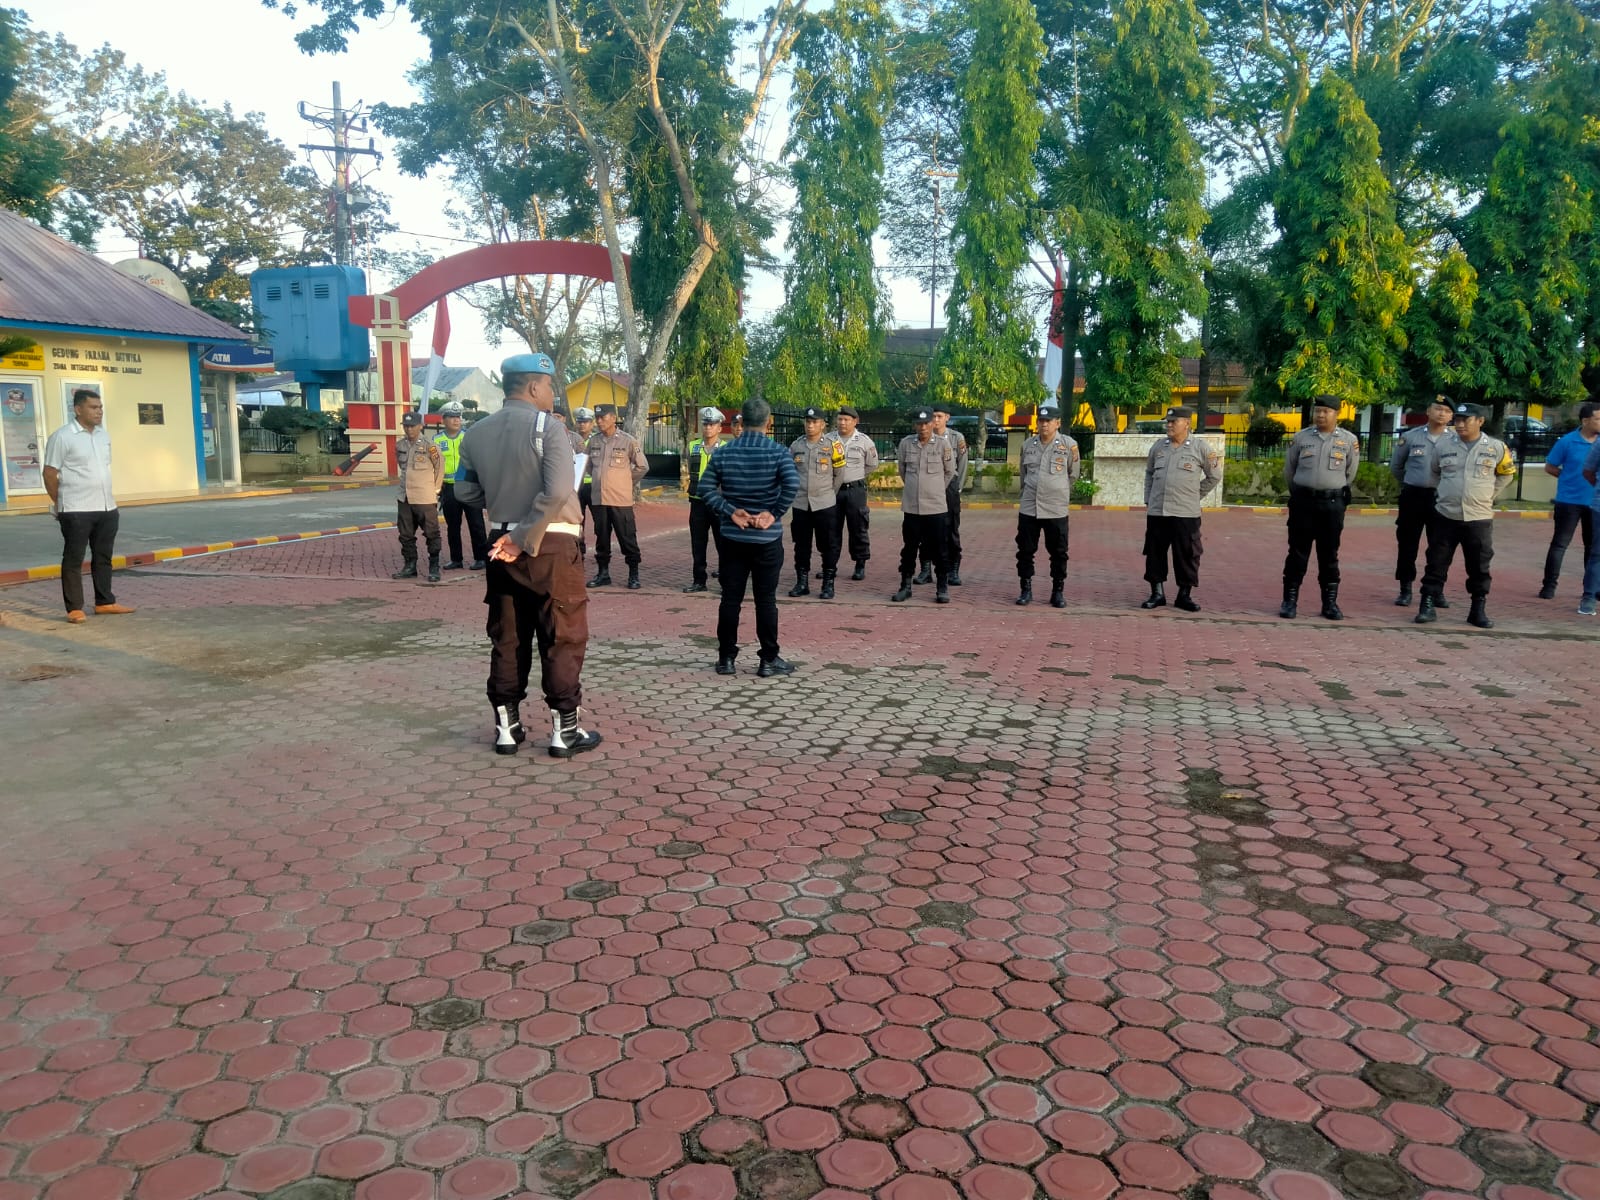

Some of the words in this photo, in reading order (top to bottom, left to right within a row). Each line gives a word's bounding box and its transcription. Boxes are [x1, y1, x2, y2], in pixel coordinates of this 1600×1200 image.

[52, 347, 79, 359] GEDUNG
[211, 353, 231, 363] ATM
[52, 362, 67, 370] ZONA
